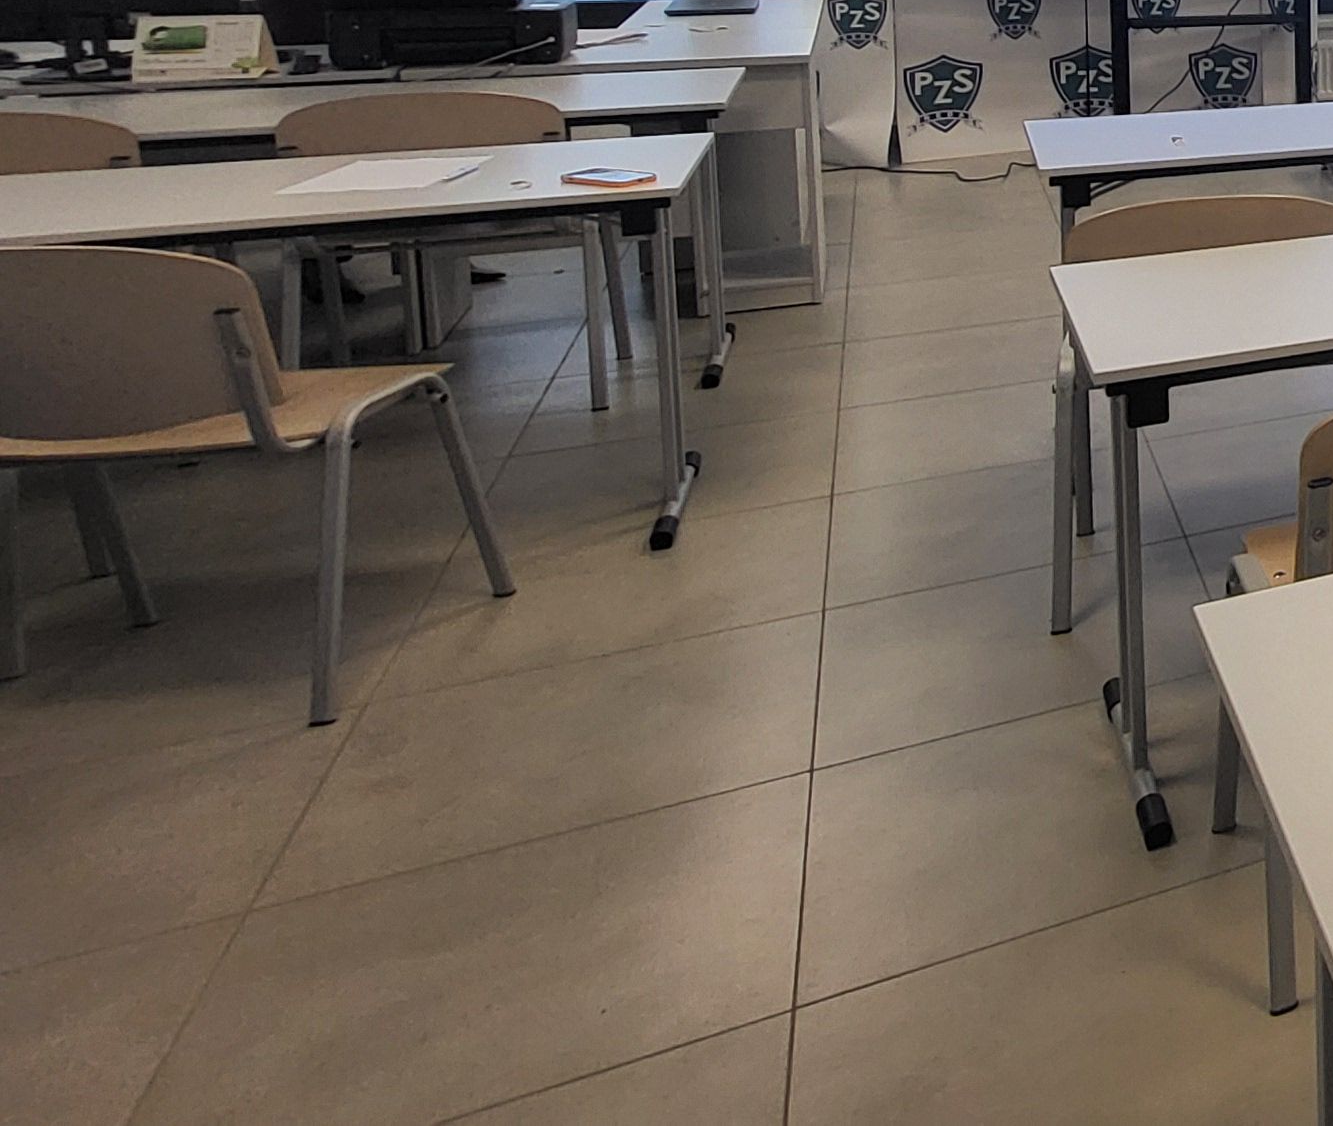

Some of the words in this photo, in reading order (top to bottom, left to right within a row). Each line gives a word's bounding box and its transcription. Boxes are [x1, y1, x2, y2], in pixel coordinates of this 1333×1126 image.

[835, 2, 880, 28] PZS
[914, 68, 974, 104] PZS
[1059, 59, 1112, 93] PZS
[1199, 57, 1250, 89] PZS
